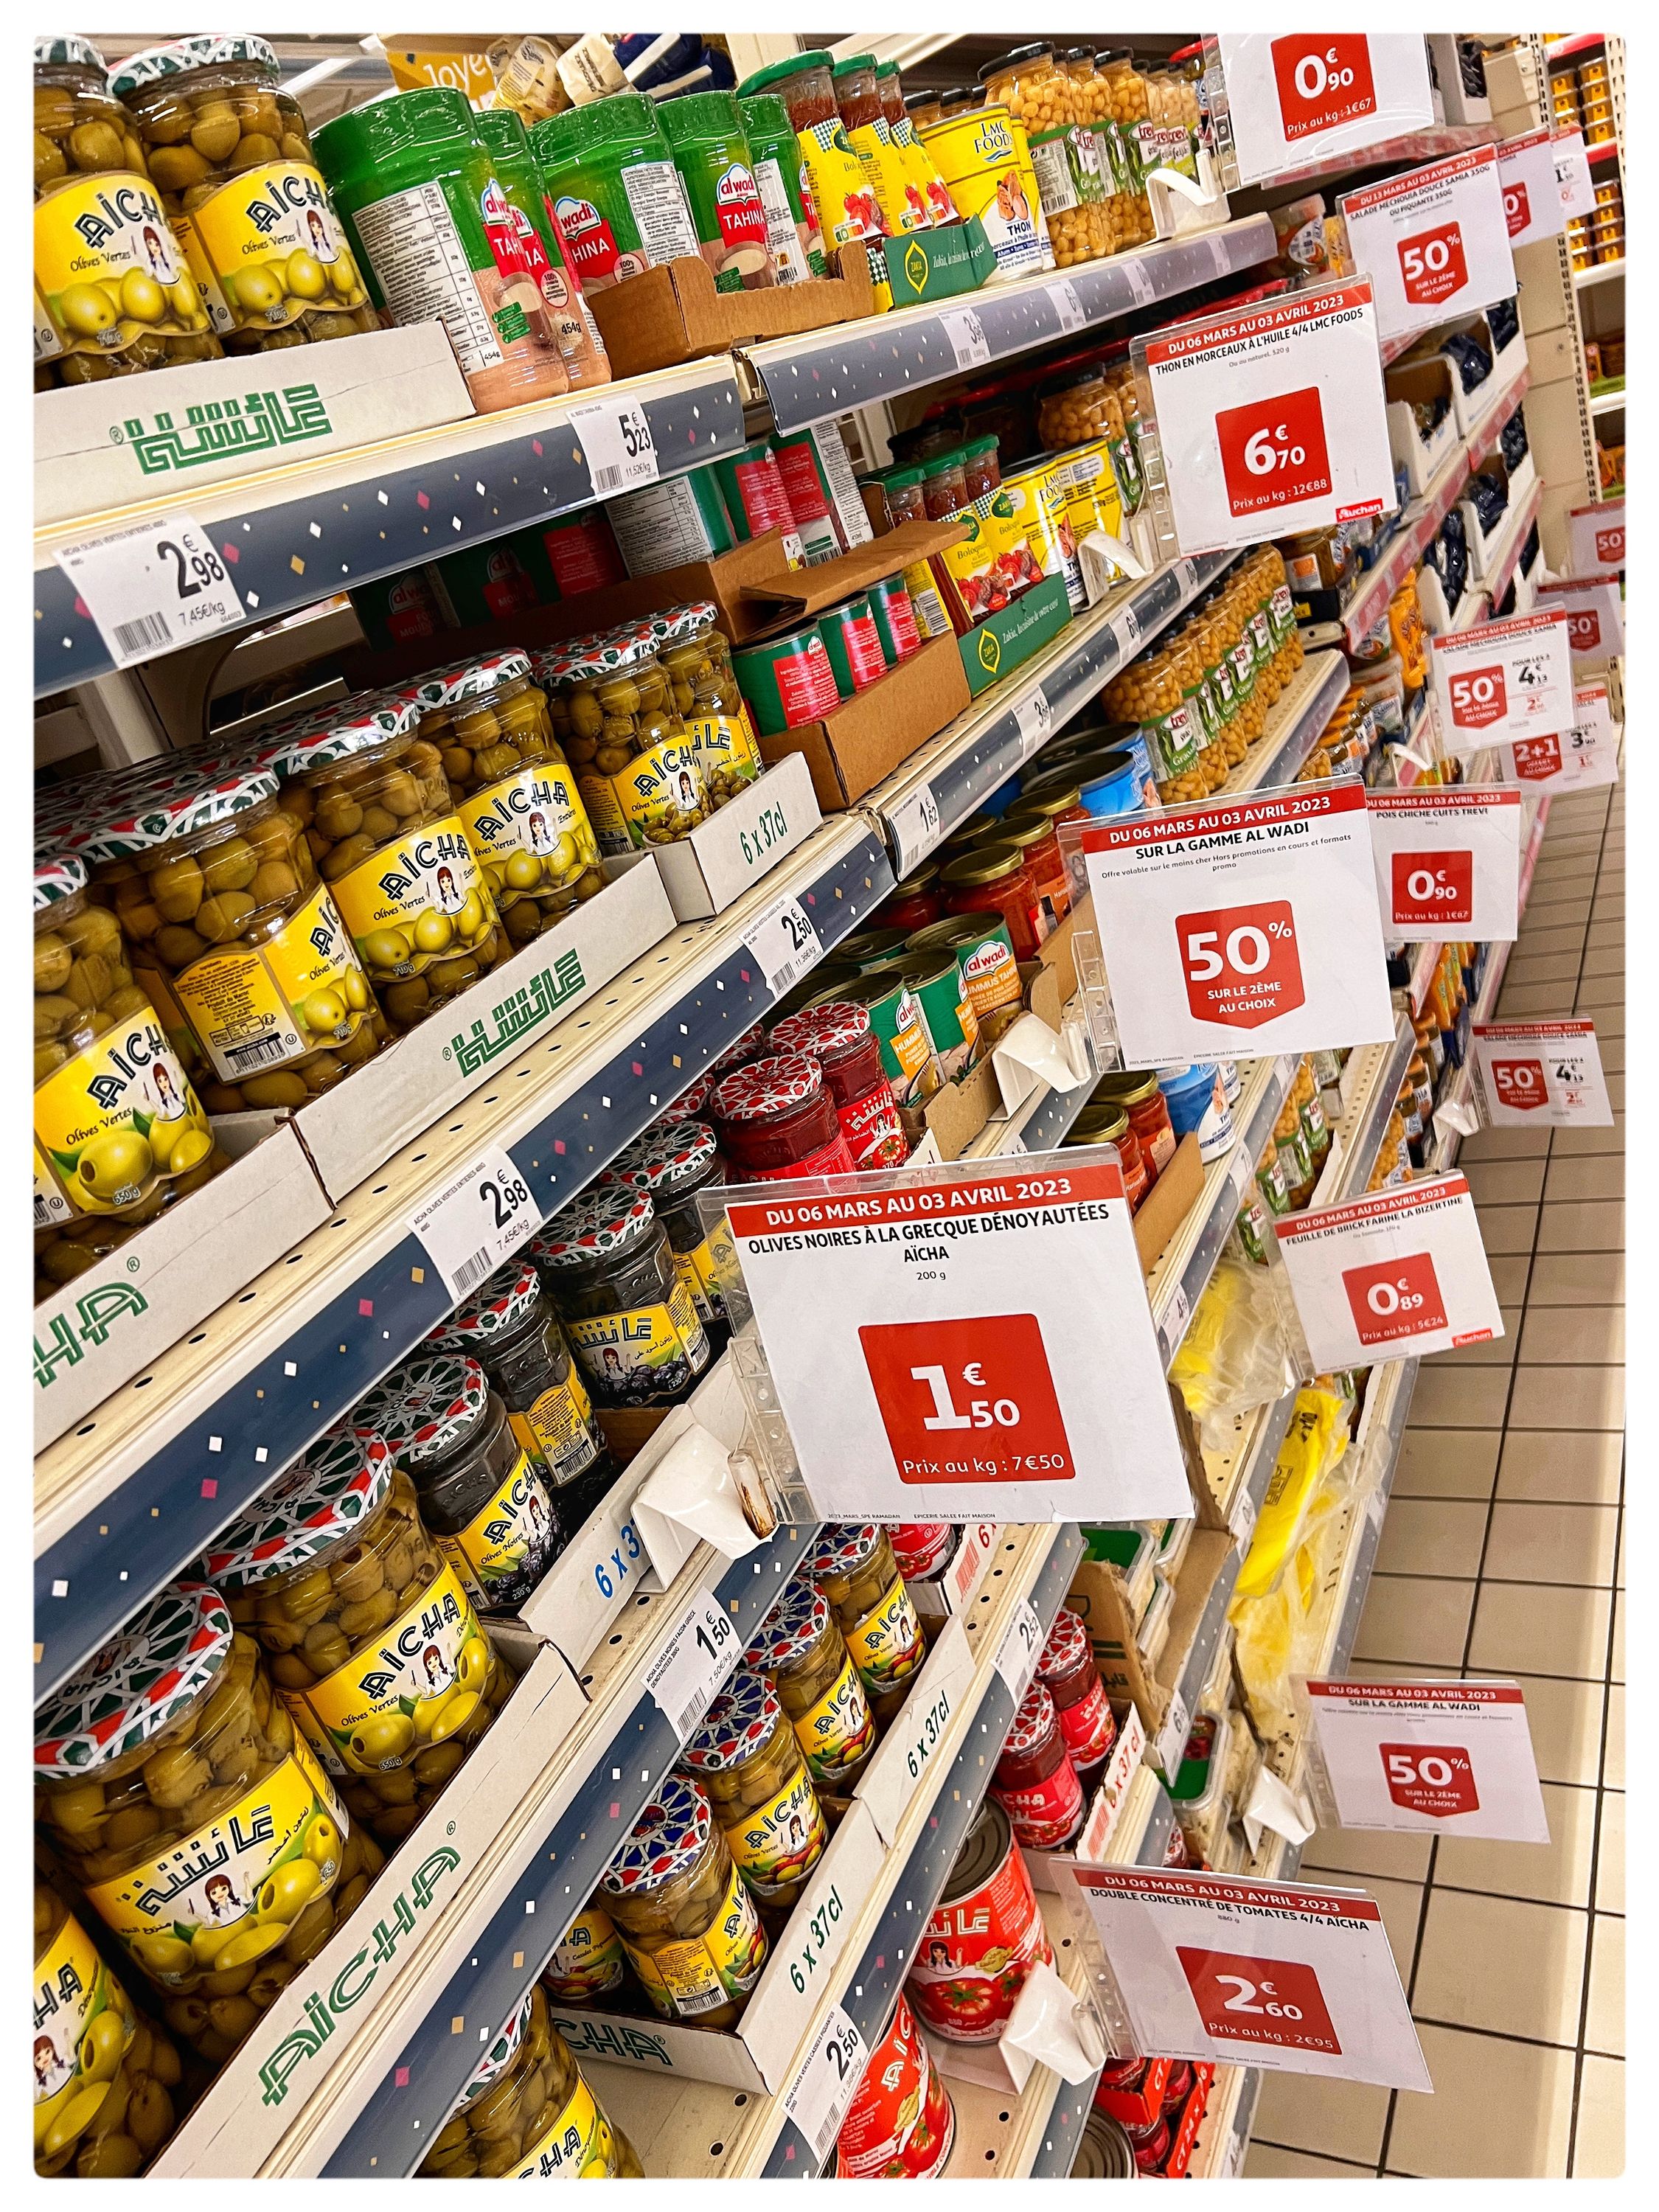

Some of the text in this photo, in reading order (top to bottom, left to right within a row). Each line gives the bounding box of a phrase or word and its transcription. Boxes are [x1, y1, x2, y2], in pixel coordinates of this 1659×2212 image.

[981, 120, 1006, 137] LMC
[1287, 119, 1307, 136] Prix
[1310, 115, 1323, 125] au
[1350, 206, 1378, 220] SALADE
[1419, 180, 1444, 195] DOUCE
[1445, 171, 1470, 186] SAMIA
[242, 230, 296, 256] Olives Vertes
[1006, 220, 1032, 236] THON
[561, 321, 582, 335] 454g
[1156, 308, 1363, 375] THON EN MORCEAUX À L'HUILE 4/4 LMC FOODS
[1233, 497, 1254, 510] Prix
[1257, 495, 1270, 505] au
[1293, 479, 1327, 496] 12€88
[1338, 503, 1381, 519] Auchan
[1110, 796, 1331, 844] DU 06 MARS AU 03 AVRIL 2023
[1376, 807, 1488, 819] POIS CHICHE CUITS TREVI
[740, 801, 788, 865] 6 x 37cl
[1135, 821, 1310, 860] SUR LA GAMME AL WADI
[1102, 870, 1120, 879] Offre
[1121, 865, 1149, 876] valable
[1172, 860, 1194, 868] moins
[1195, 855, 1211, 864] cher
[1213, 853, 1231, 862] Hors
[1232, 846, 1276, 860] promotions
[1288, 841, 1310, 849] cours
[1321, 834, 1352, 844] formats
[1212, 863, 1237, 872] promo
[373, 892, 425, 923] Olives Vertes
[1207, 981, 1282, 1001] SUR LE 2ÈME
[1217, 996, 1277, 1015] AU CHOIX
[66, 1105, 134, 1147] Olives Vertes
[766, 1178, 1072, 1226] DU 06 MARS AU 03 AVRIL 2023
[748, 1203, 1110, 1254] OLIVES NOIRES À LA GRECQUE DÉNOYAUTÉES
[1287, 1196, 1463, 1245] FEUILLE DE BRICK FARINE LA BIZERTINE
[904, 1245, 950, 1263] AÏCHA
[917, 1271, 946, 1280] 200 g
[902, 1453, 1065, 1475] Prix au kg 7€50
[481, 1532, 524, 1565] Olives Noires
[646, 1669, 657, 1684] AICHA
[655, 1653, 667, 1670] OLIVES
[341, 1694, 399, 1728] Olives Vertes
[1388, 1700, 1429, 1709] GAMME
[1449, 1703, 1481, 1711] WADI
[907, 1694, 951, 1778] 6 x 37cl
[1090, 1888, 1370, 1931] DOUBLE CONCENTRÉ DE TOMATES 4/4 AÏCHA
[1208, 2021, 1239, 2036] Prix
[1242, 2027, 1260, 2039] au
[1295, 2034, 1334, 2050] 2€95
